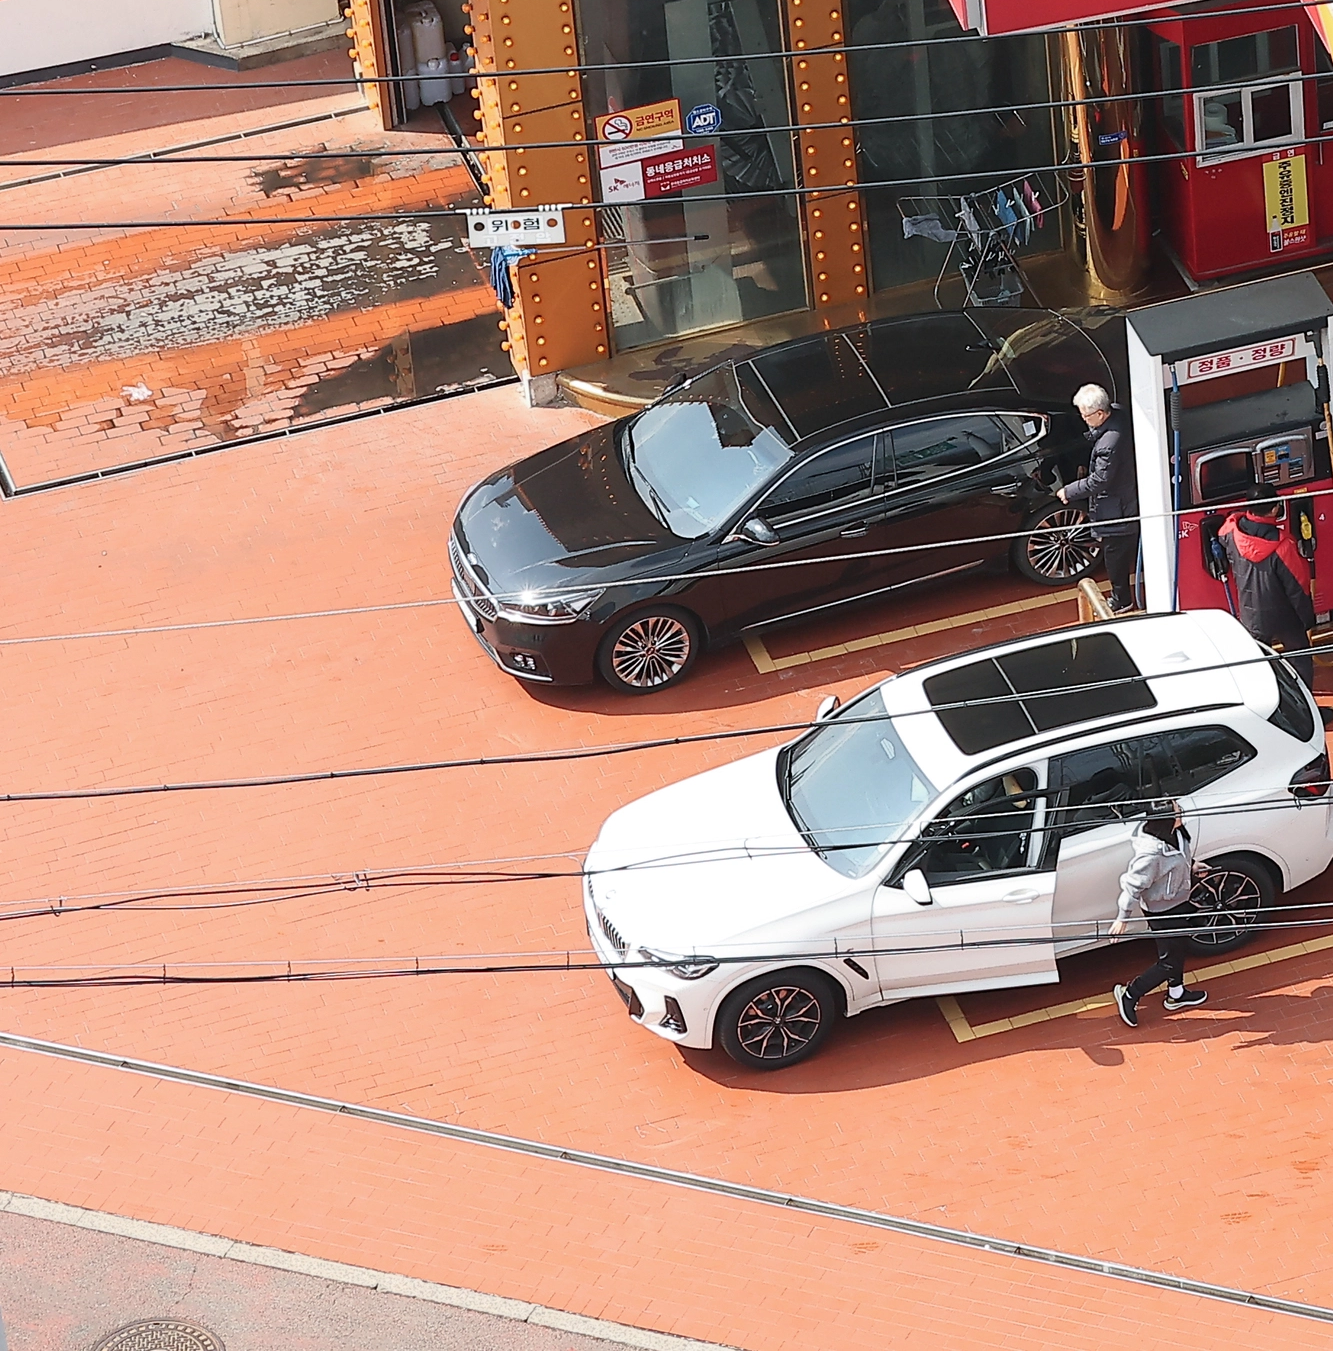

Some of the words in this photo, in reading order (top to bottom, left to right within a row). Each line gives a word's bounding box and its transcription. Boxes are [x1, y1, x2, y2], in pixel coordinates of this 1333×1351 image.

[635, 109, 674, 127] 금연구역
[692, 112, 716, 128] ADT
[608, 184, 619, 193] SK
[1198, 355, 1231, 373] 정품
[1252, 343, 1286, 361] 정량
